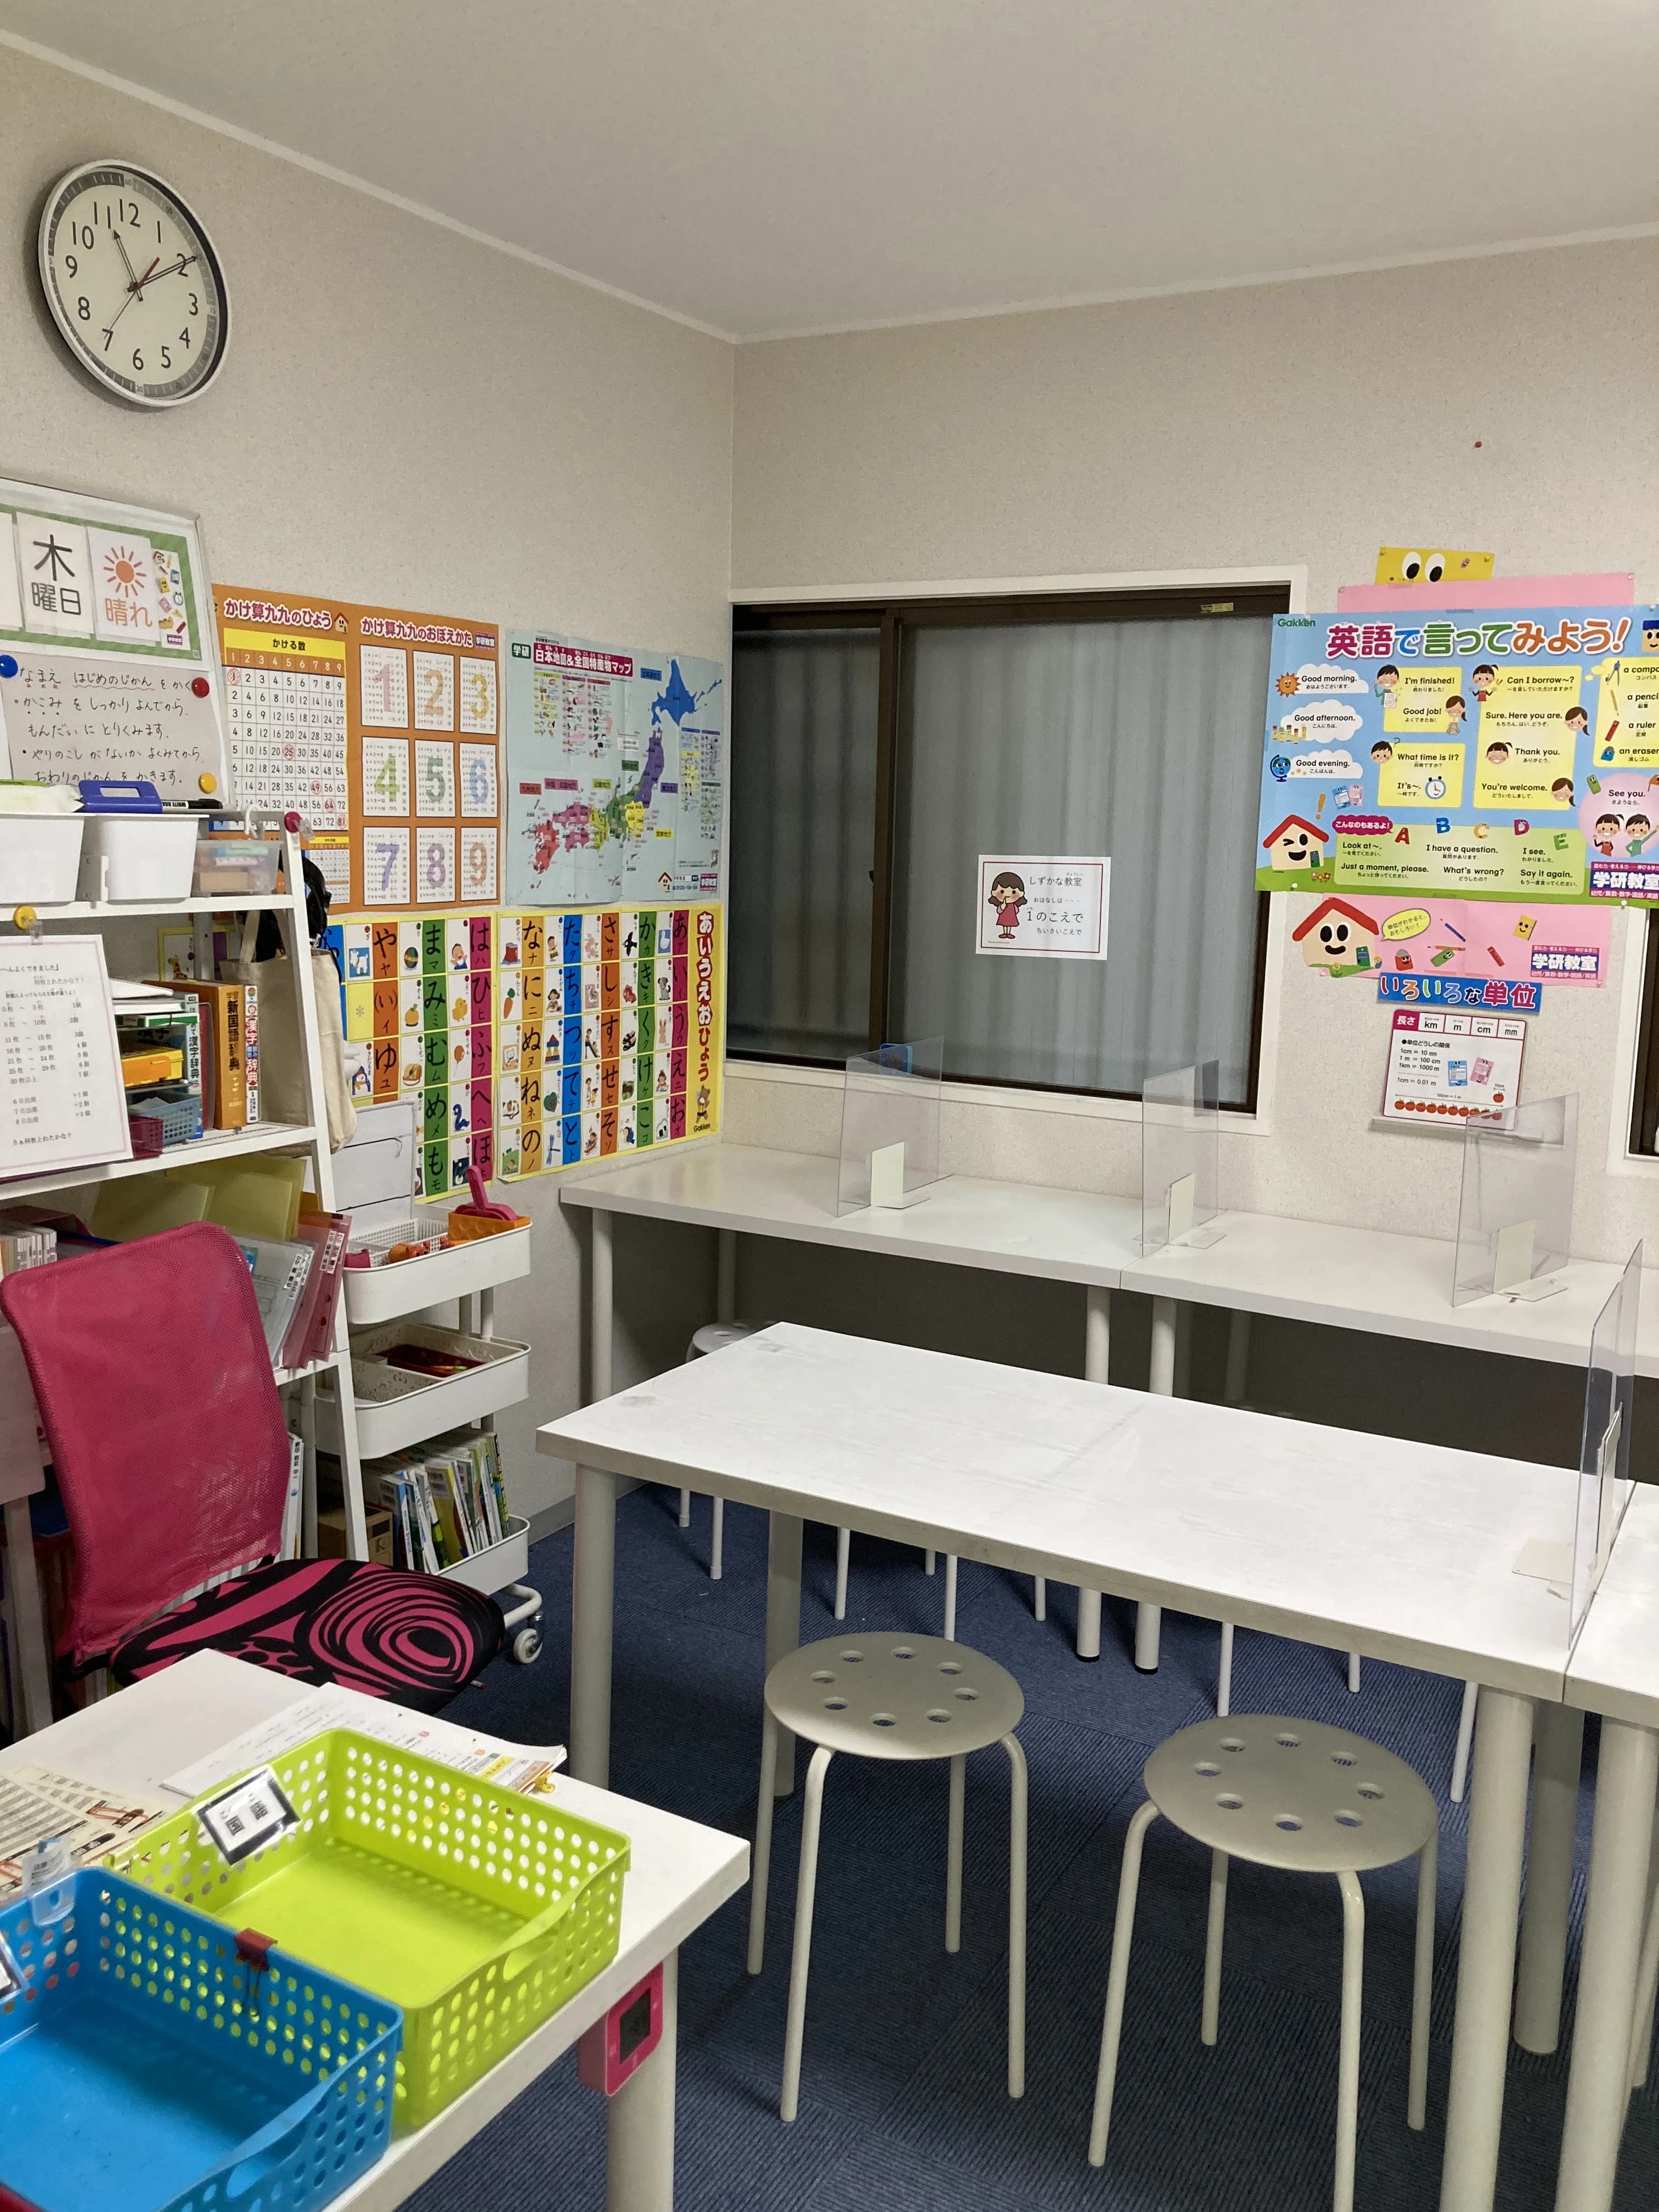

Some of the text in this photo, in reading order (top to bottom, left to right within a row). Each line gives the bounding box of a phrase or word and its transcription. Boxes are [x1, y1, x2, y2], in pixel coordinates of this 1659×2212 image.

[93, 201, 111, 229] 11
[119, 199, 140, 228] 12
[72, 221, 94, 250] 10
[157, 221, 161, 244] 1
[65, 255, 78, 278] 9
[176, 253, 189, 277] 2
[78, 296, 91, 320] 8
[189, 293, 199, 315] 3
[101, 329, 114, 351] 7
[179, 327, 191, 349] 4
[132, 348, 144, 370] 6
[161, 346, 172, 369] 5
[33, 534, 75, 581] 木
[31, 582, 82, 616] 曜日
[105, 597, 154, 628] 晴れ
[225, 600, 331, 628] かけ算九九のひょう
[1278, 618, 1316, 627] Gakken
[362, 618, 472, 646] かけ算九九のおぼえかた
[273, 639, 306, 651] かける数
[514, 645, 529, 657] 学研
[20, 668, 61, 684] なまえ
[74, 672, 152, 687] はじめのじかん
[173, 681, 191, 690] かく
[24, 696, 62, 709] かこみ
[74, 698, 81, 710] を
[89, 698, 129, 712] しっかり
[424, 670, 444, 715] 2
[471, 674, 489, 719] 3
[1426, 708, 1442, 716] job!
[28, 724, 78, 737] もんだい
[85, 725, 94, 735] に
[32, 748, 82, 760] やりのこし
[375, 755, 489, 803] 4 5 6
[1461, 846, 1498, 854] question.
[376, 844, 399, 889] 7
[427, 843, 445, 888] 8
[470, 843, 487, 885] 9
[1402, 865, 1429, 873] please.
[1474, 868, 1504, 876] wrong?
[1520, 870, 1536, 878] Say
[1547, 871, 1572, 879] again.
[1030, 877, 1082, 887] しずかな教室
[1593, 872, 1659, 889] 学研教室
[1532, 953, 1597, 971] 学研教室
[697, 912, 713, 1081] あいうえおひょう
[1380, 977, 1536, 1008] いろいろな単位
[671, 913, 688, 1123] あ い う え お
[1397, 1015, 1416, 1025] 長さ
[694, 1124, 710, 1133] Gakken
